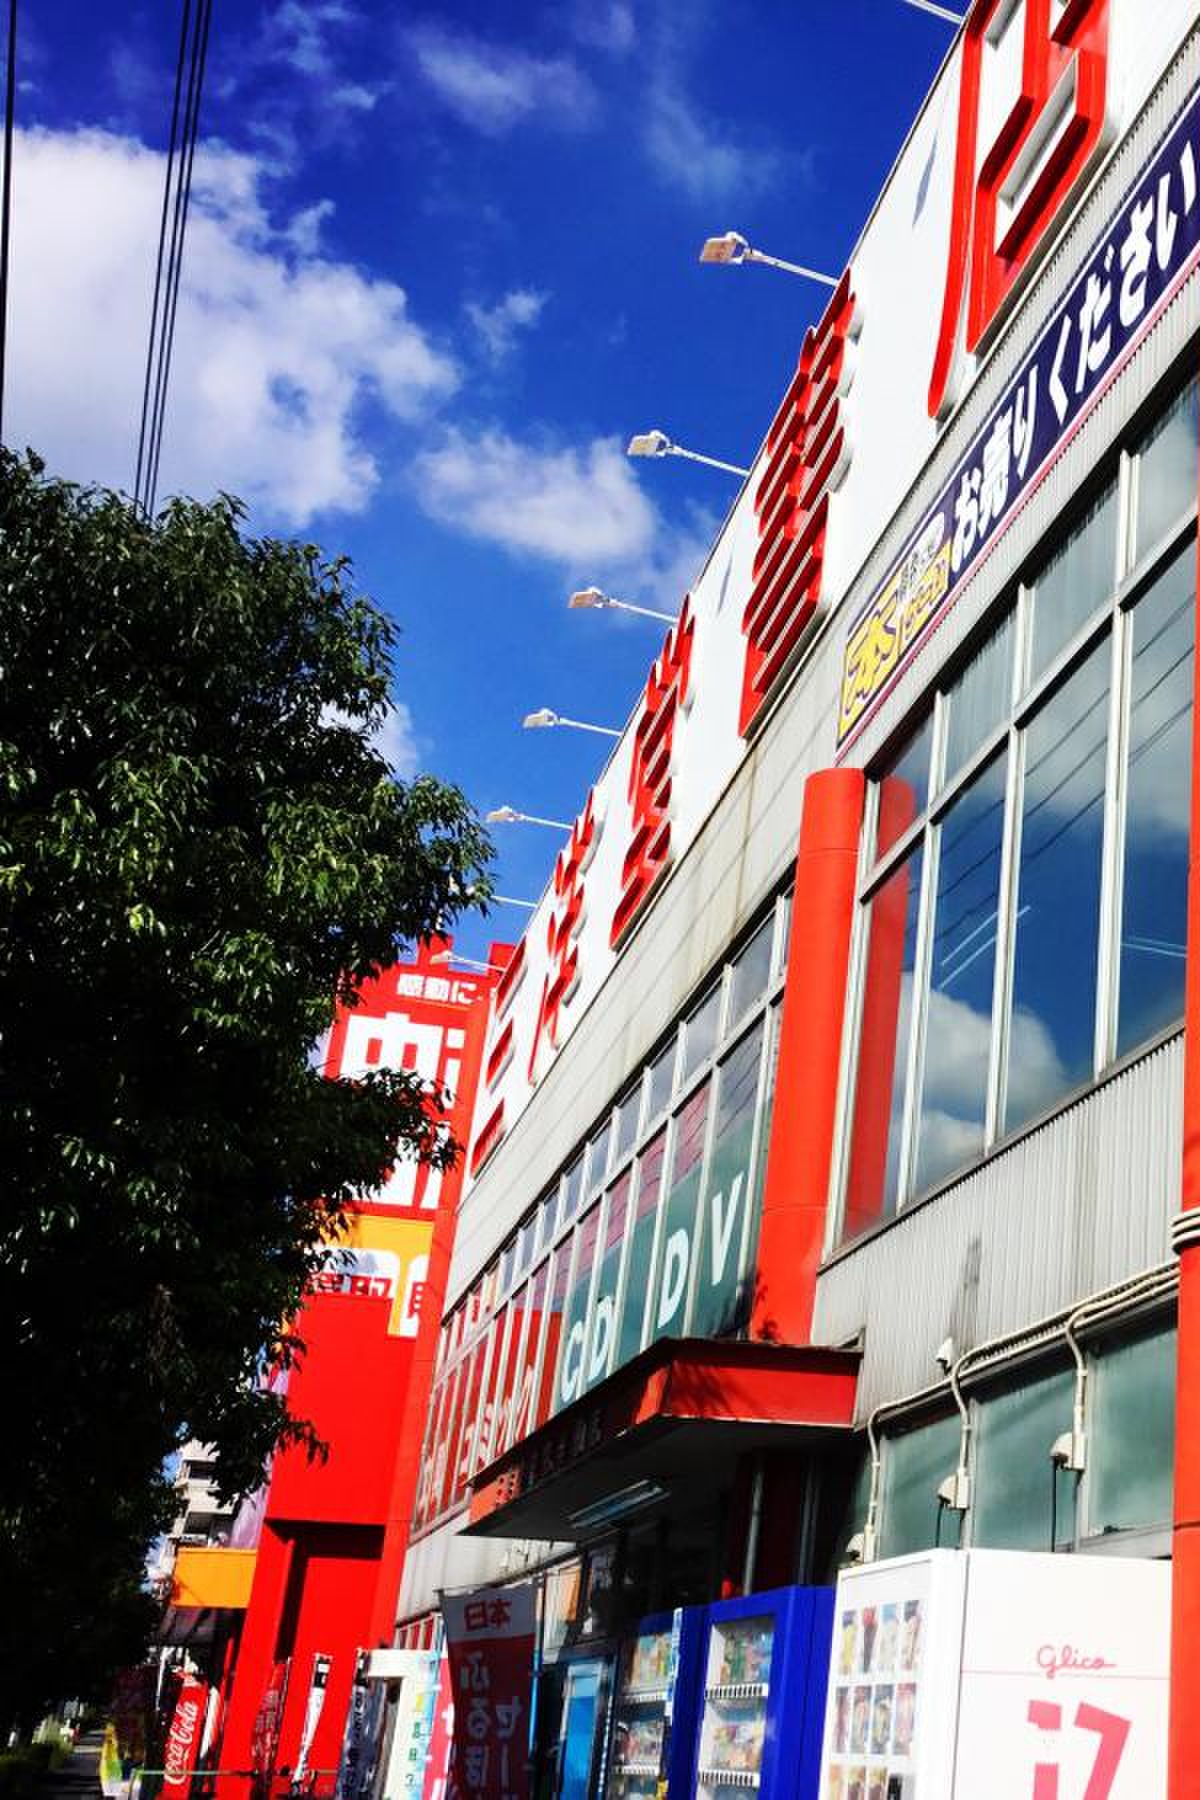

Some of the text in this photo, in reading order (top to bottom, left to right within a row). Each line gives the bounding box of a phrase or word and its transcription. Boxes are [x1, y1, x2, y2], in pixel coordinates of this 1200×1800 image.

[951, 140, 1197, 573] お売りください
[1036, 1644, 1117, 1680] Glico
